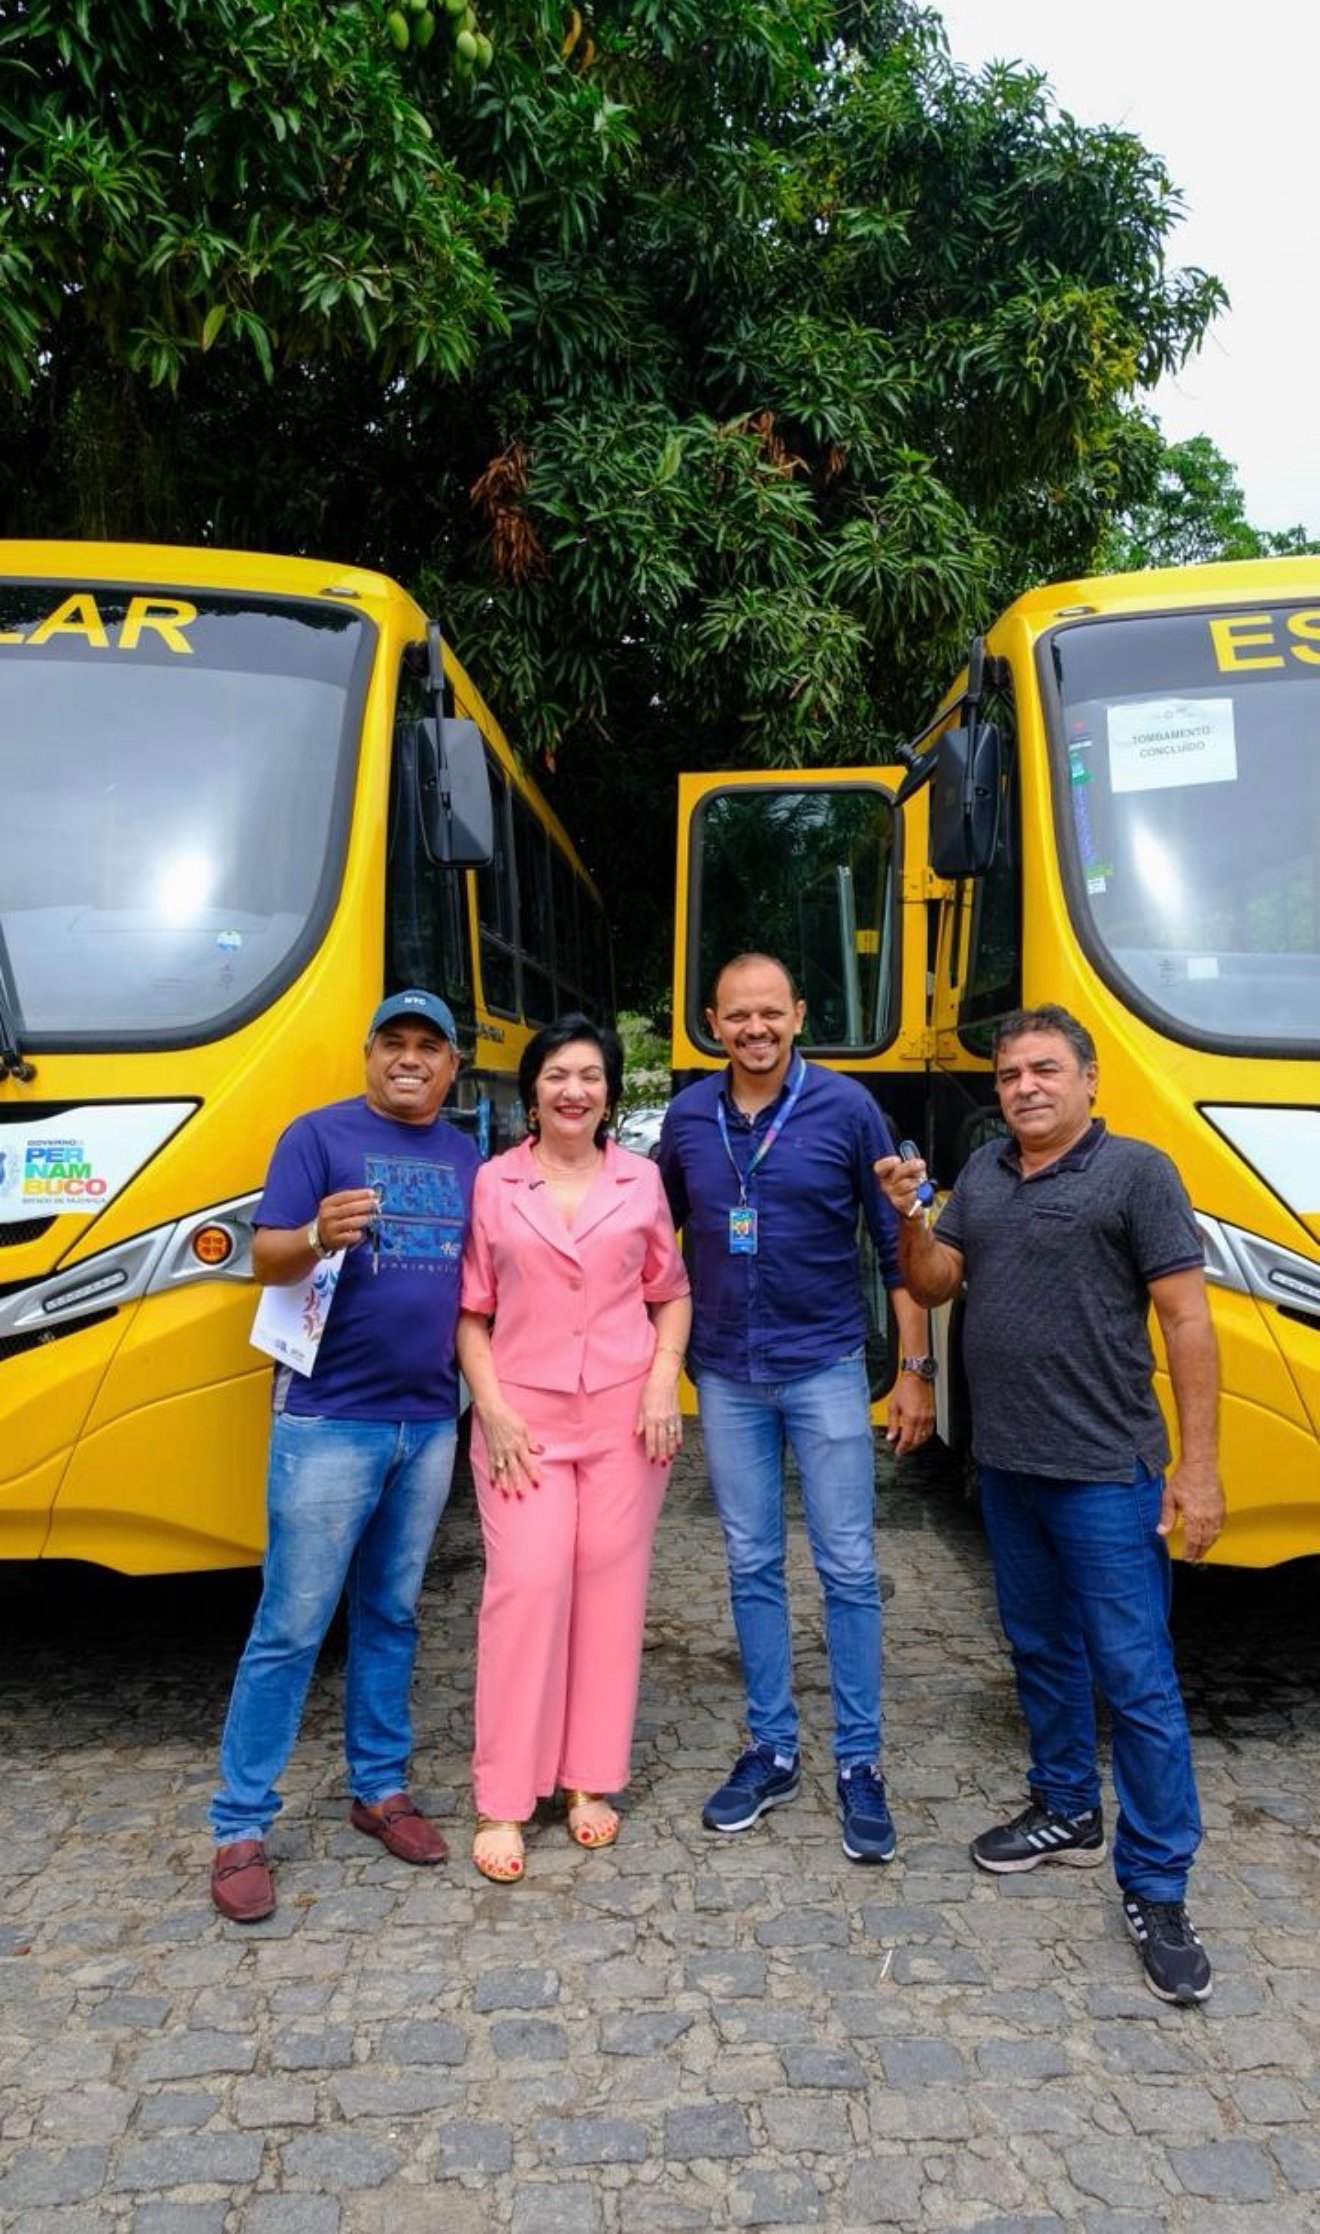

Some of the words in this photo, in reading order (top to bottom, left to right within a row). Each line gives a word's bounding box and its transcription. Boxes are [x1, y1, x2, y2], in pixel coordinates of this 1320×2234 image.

[25, 1147, 84, 1163] PER
[25, 1163, 91, 1178] NAM
[23, 1178, 107, 1196] BUCO
